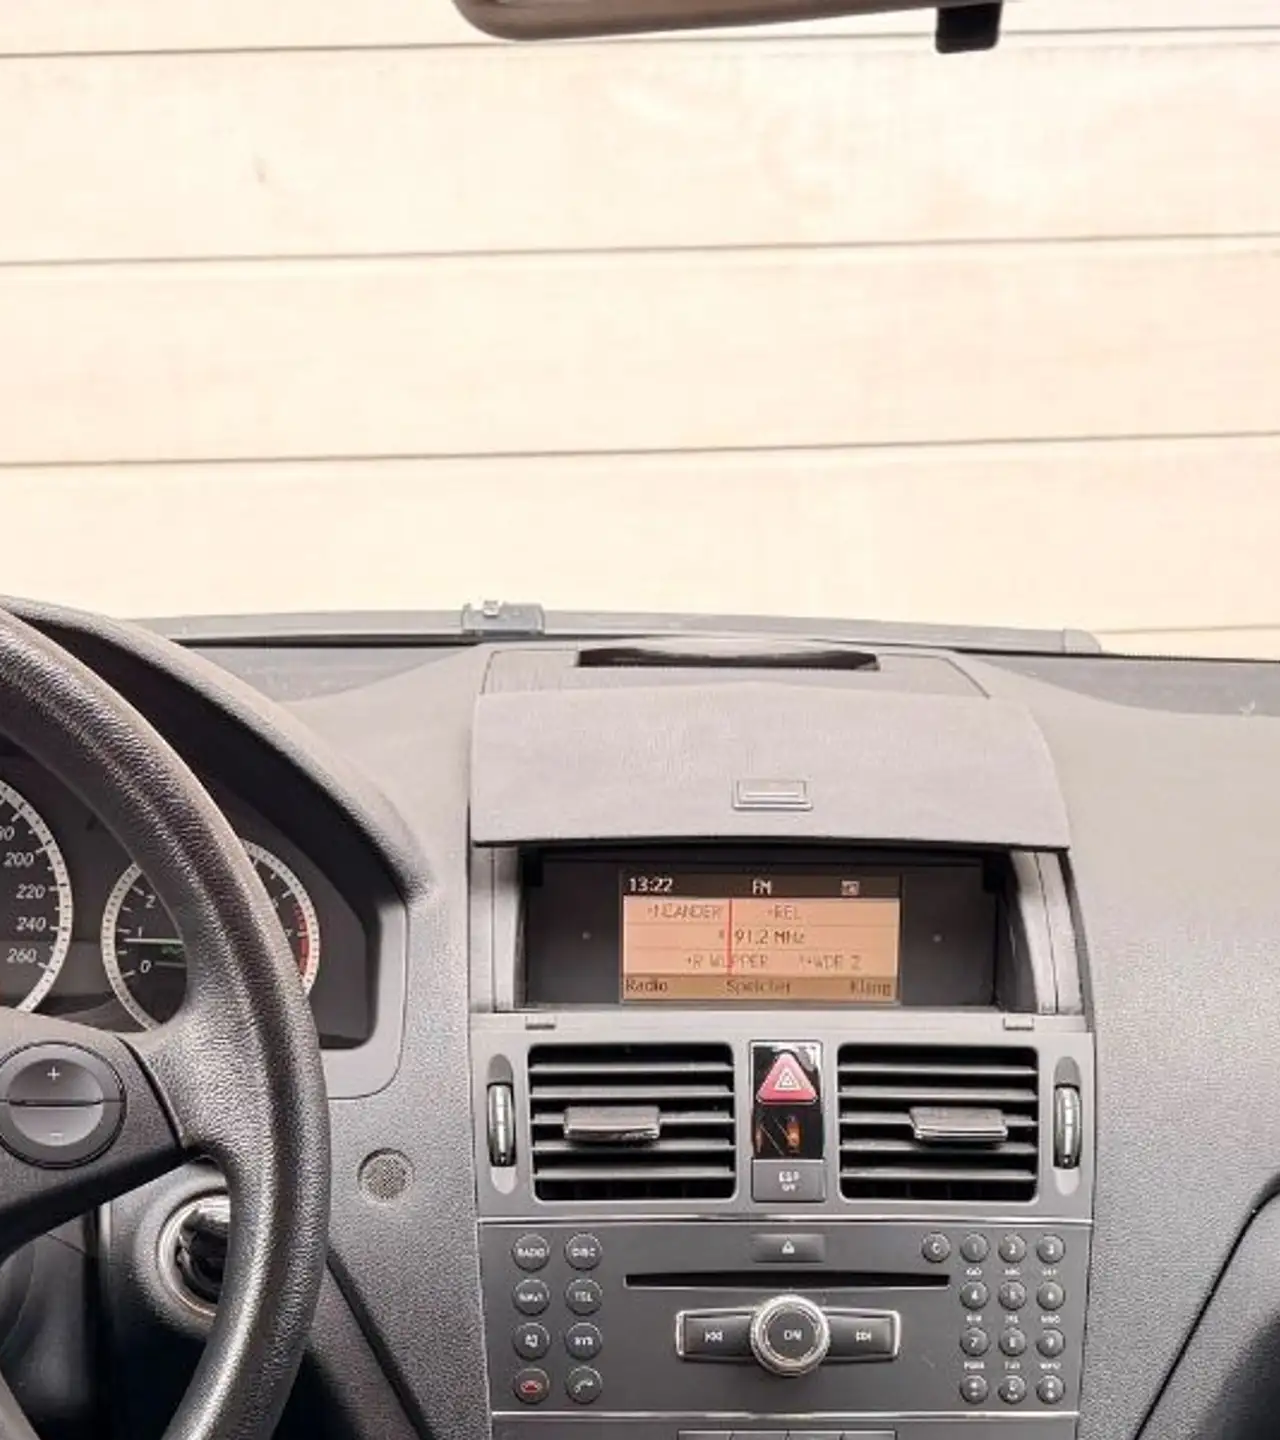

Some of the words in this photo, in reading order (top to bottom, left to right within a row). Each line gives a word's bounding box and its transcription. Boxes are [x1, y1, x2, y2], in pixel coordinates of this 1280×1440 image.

[3, 853, 34, 867] 200
[629, 877, 673, 892] 13:22
[752, 879, 773, 895] FM
[16, 885, 46, 899] 220
[144, 895, 156, 909] 2
[16, 917, 46, 931] 240
[6, 949, 37, 963] 260
[140, 960, 152, 973] 0
